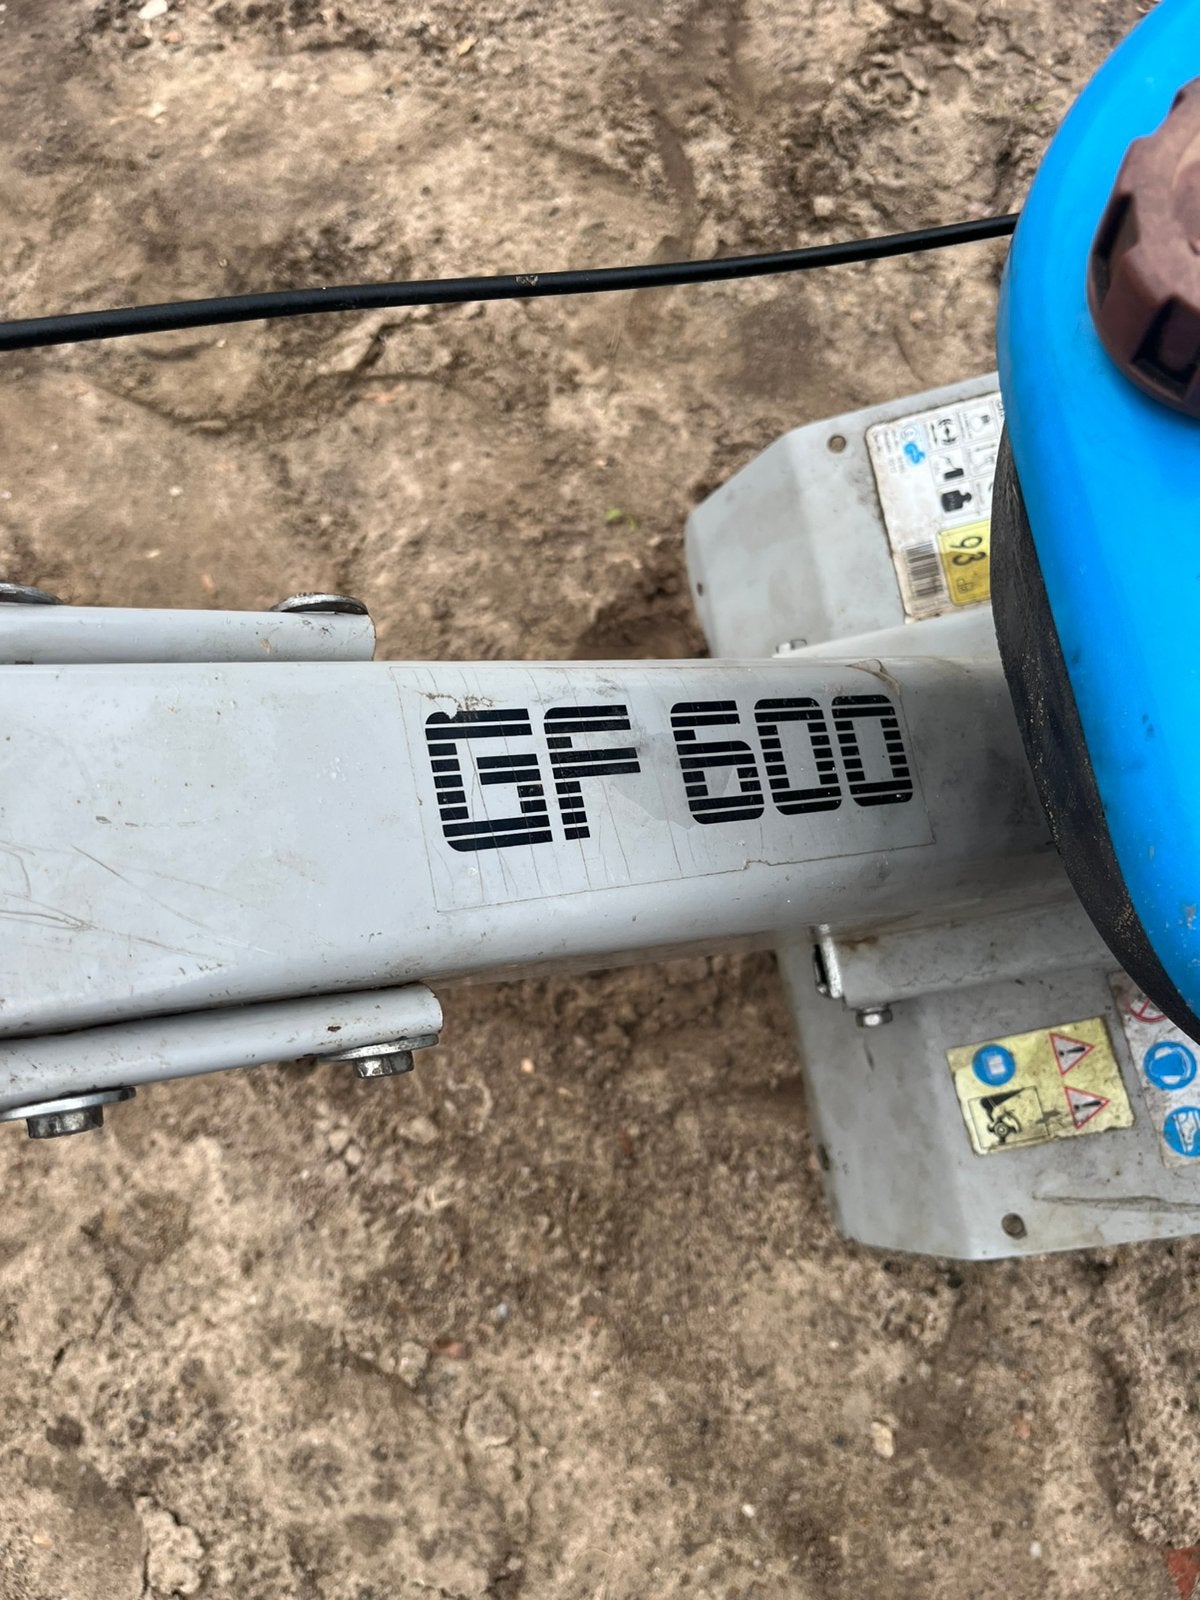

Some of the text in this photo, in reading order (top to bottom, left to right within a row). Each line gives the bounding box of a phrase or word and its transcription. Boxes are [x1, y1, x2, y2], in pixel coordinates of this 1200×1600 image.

[949, 536, 986, 566] 93
[425, 694, 913, 852] GF 600
